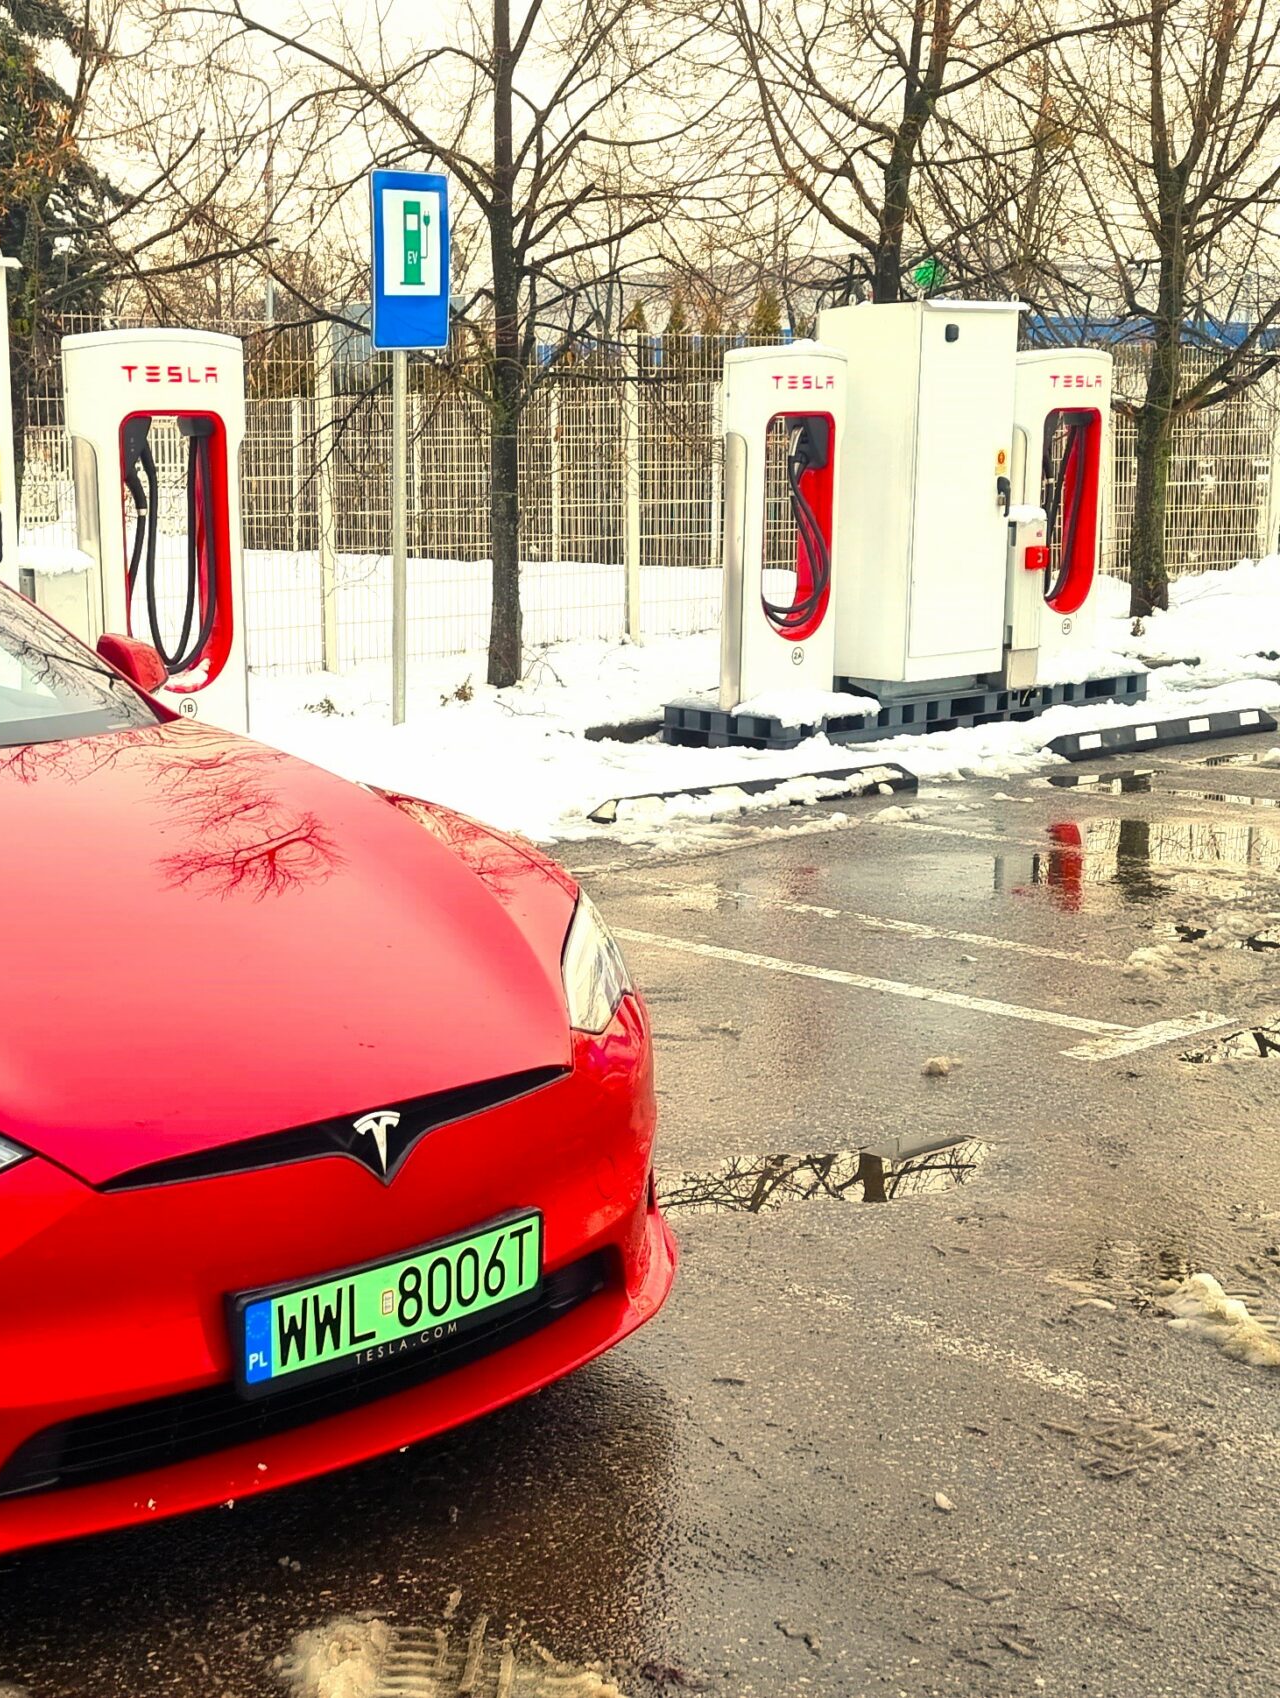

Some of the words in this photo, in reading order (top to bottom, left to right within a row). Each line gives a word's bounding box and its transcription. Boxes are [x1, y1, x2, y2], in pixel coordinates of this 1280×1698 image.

[407, 250, 418, 264] EV
[120, 365, 218, 383] TESLA
[771, 375, 834, 389] TESLA
[1049, 375, 1102, 388] TESLA
[183, 704, 194, 713] 1B
[277, 1284, 376, 1367] WWL
[398, 1224, 533, 1327] 8006T
[355, 1321, 458, 1365] TESLA.COM
[248, 1351, 268, 1371] PL
